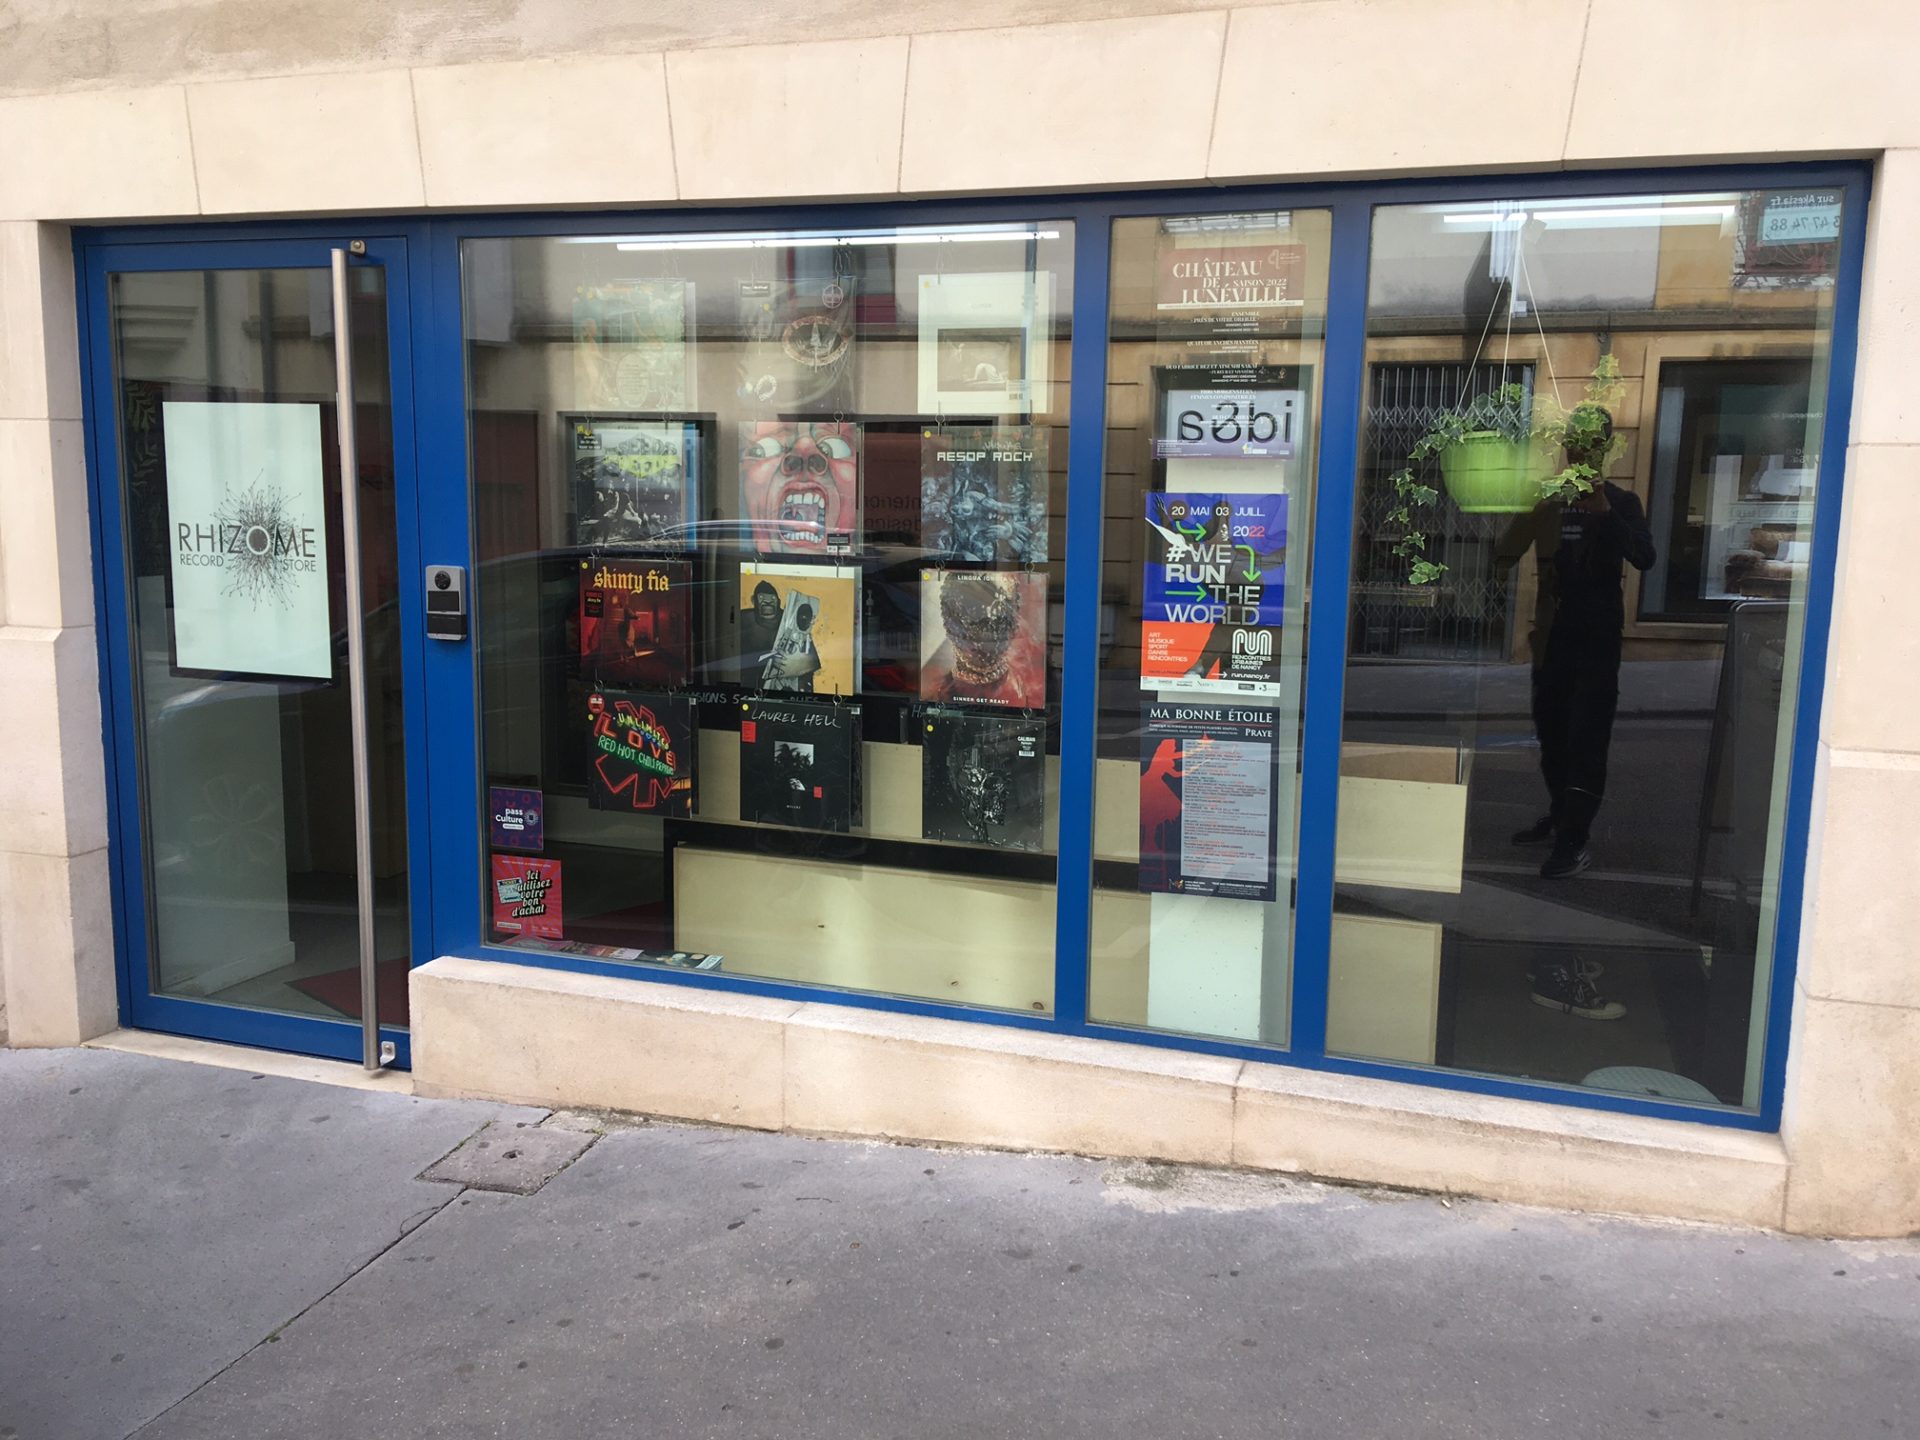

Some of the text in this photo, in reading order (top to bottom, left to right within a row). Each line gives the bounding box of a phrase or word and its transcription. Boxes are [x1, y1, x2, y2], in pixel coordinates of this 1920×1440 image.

[1172, 257, 1262, 278] CHÂTEAU
[1203, 277, 1220, 288] DE
[1266, 278, 1287, 286] 2022
[1182, 284, 1287, 304] LUNÉVILLE
[937, 452, 1033, 462] AESOP ROCK
[1171, 506, 1266, 517] 20 MAI 03 JUILL.
[1233, 526, 1265, 538] 2022
[178, 522, 316, 558] RHIZOME
[180, 554, 316, 572] RECORD STORE
[593, 566, 670, 594] skinty fia
[1165, 564, 1226, 584] RUN
[1208, 585, 1260, 606] THE
[1164, 604, 1260, 626] WORLD
[752, 710, 842, 728] LAUREL HELL
[1150, 708, 1272, 723] MA BONNE ÉTOILE
[598, 735, 616, 752] RED
[618, 744, 636, 760] HOT
[602, 716, 676, 766] LOVE
[496, 814, 524, 824] Culture
[505, 808, 524, 817] pass
[526, 870, 538, 880] Ici
[517, 879, 551, 892] utilisez
[520, 890, 544, 899] votre
[522, 898, 540, 907] bon
[512, 905, 544, 917] d'achat
